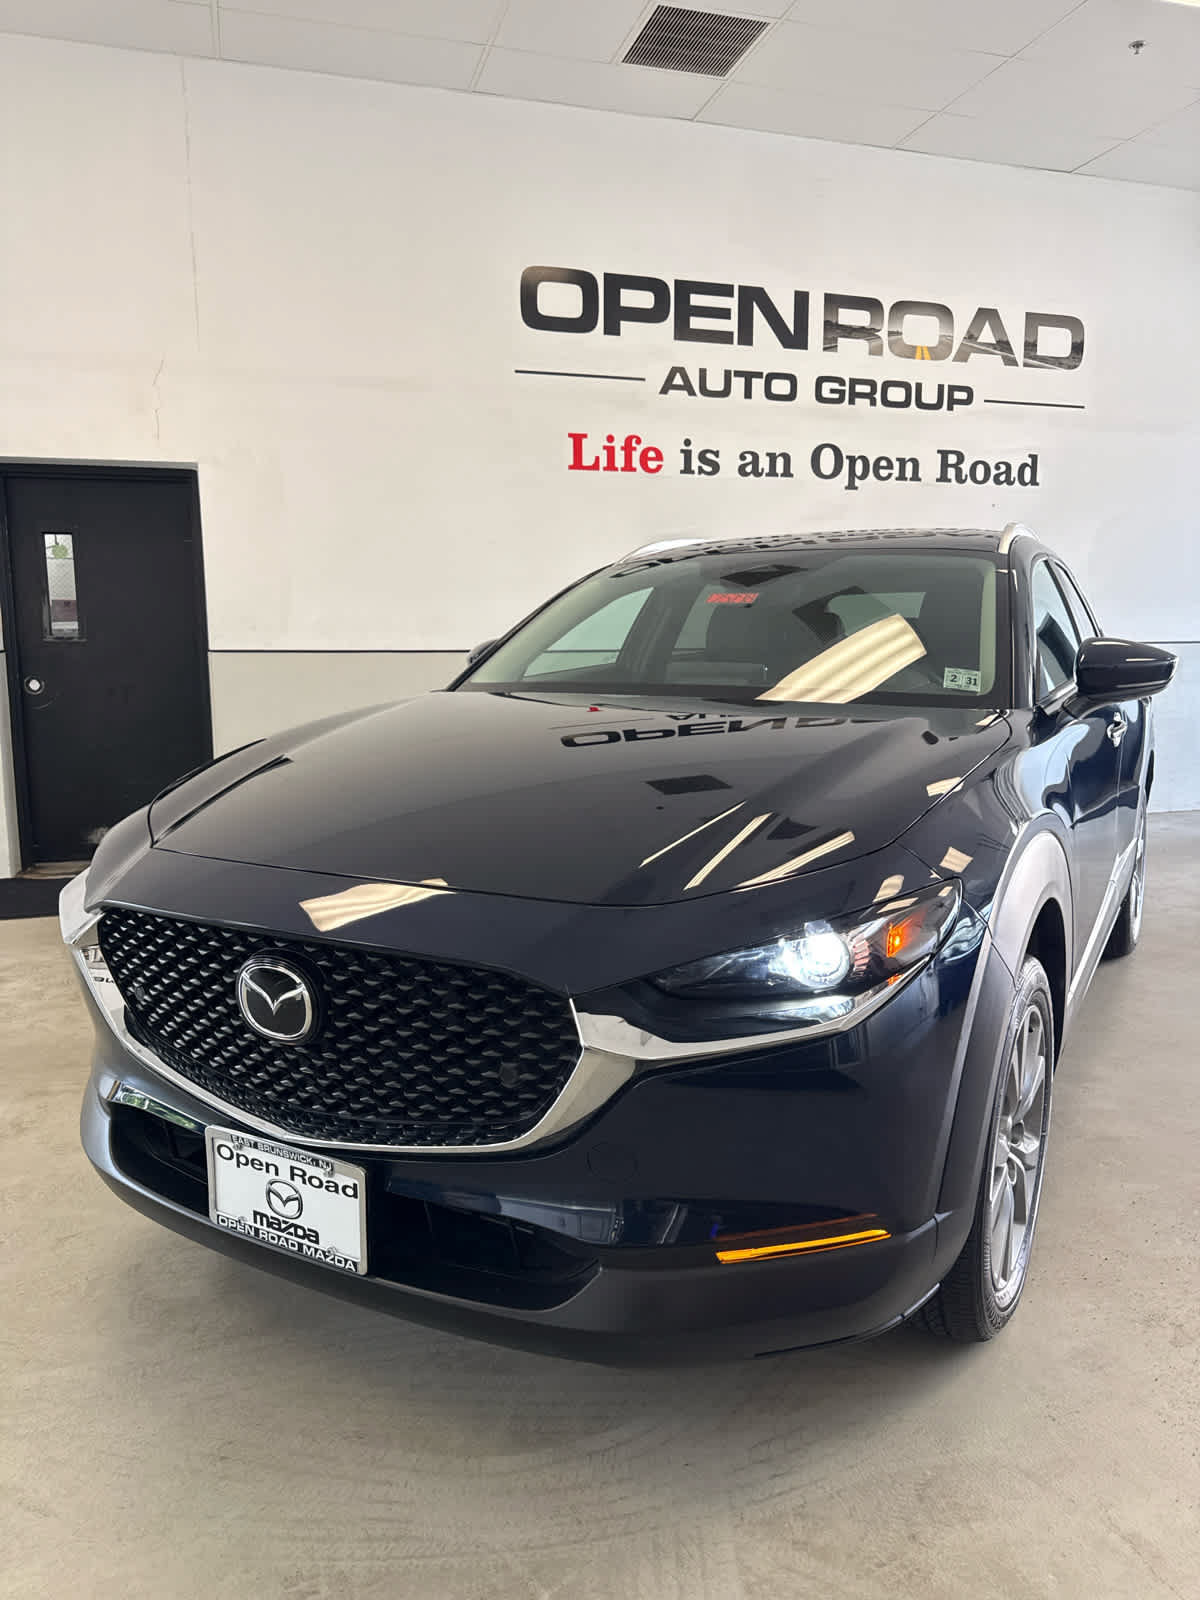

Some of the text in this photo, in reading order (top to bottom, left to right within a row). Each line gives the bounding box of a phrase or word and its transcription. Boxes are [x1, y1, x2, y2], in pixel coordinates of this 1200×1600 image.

[519, 265, 1085, 370] OPEN ROAD
[658, 366, 974, 412] AUTO GROUP
[567, 432, 1040, 491] Life is an Open Road
[950, 674, 977, 686] 2 31
[216, 1143, 359, 1200] Open Road
[232, 1135, 255, 1148] EAST
[319, 1158, 334, 1171] NJ
[218, 1214, 356, 1272] OPEN ROAD MAZDA
